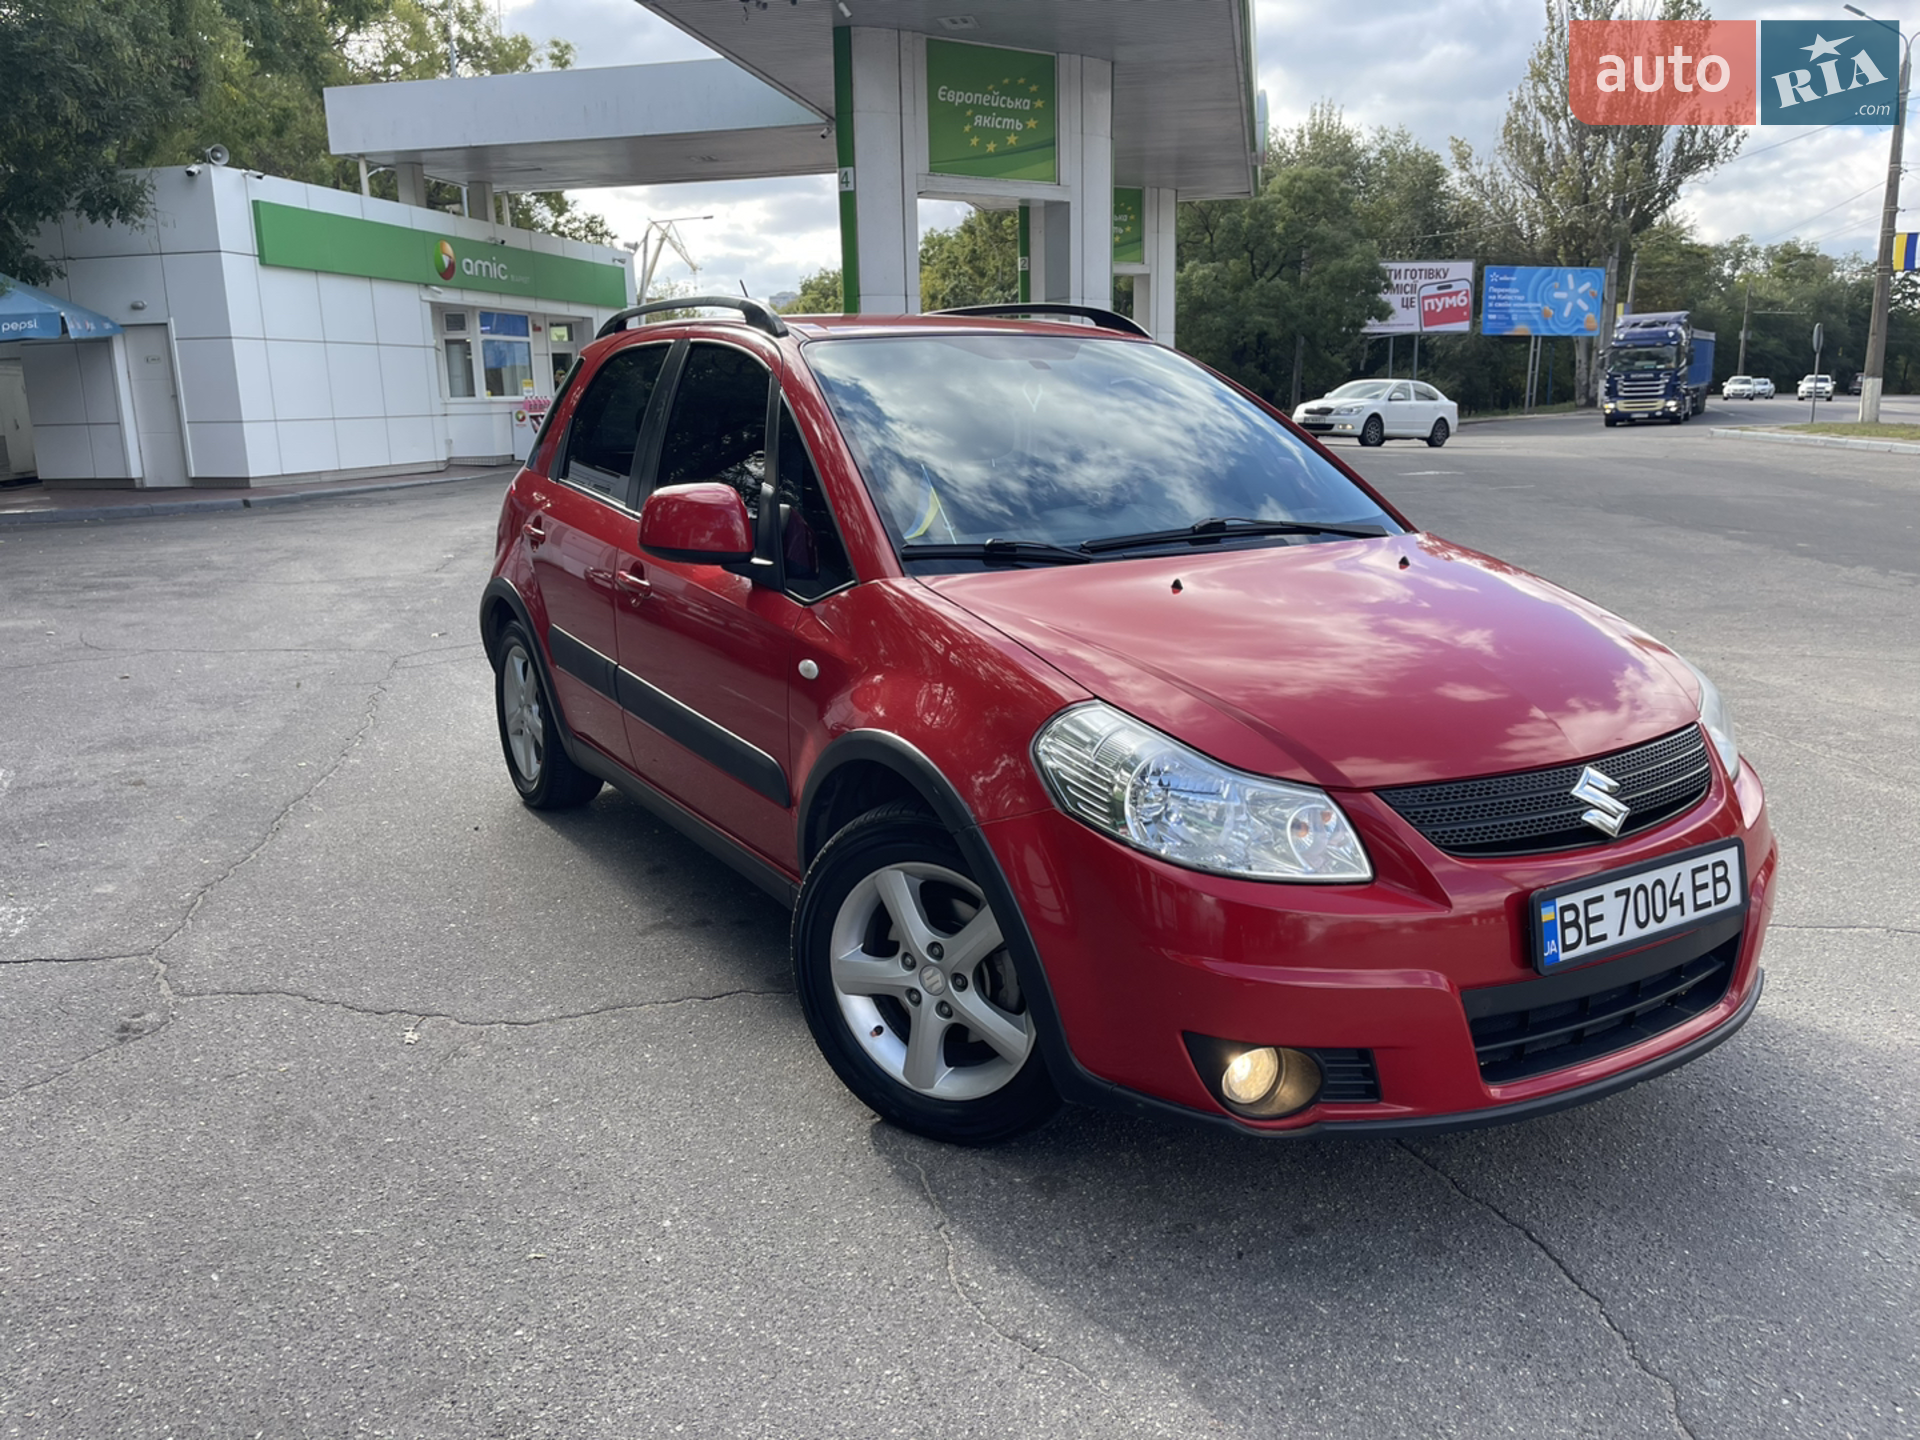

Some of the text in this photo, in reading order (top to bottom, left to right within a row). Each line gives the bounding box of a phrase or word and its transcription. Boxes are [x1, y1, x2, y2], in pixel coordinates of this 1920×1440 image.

[937, 85, 1031, 110] Європейська
[973, 112, 1024, 131] якість
[840, 171, 851, 187] 4
[462, 256, 508, 280] amic
[1020, 258, 1027, 269] 2
[1387, 267, 1450, 280] ТИ ГОТІВКУ
[1382, 280, 1418, 295] ОМІСІЇ
[1401, 297, 1416, 310] ЦЕ
[2, 319, 37, 333] pepsi
[1559, 859, 1731, 953] BE 7004 EB
